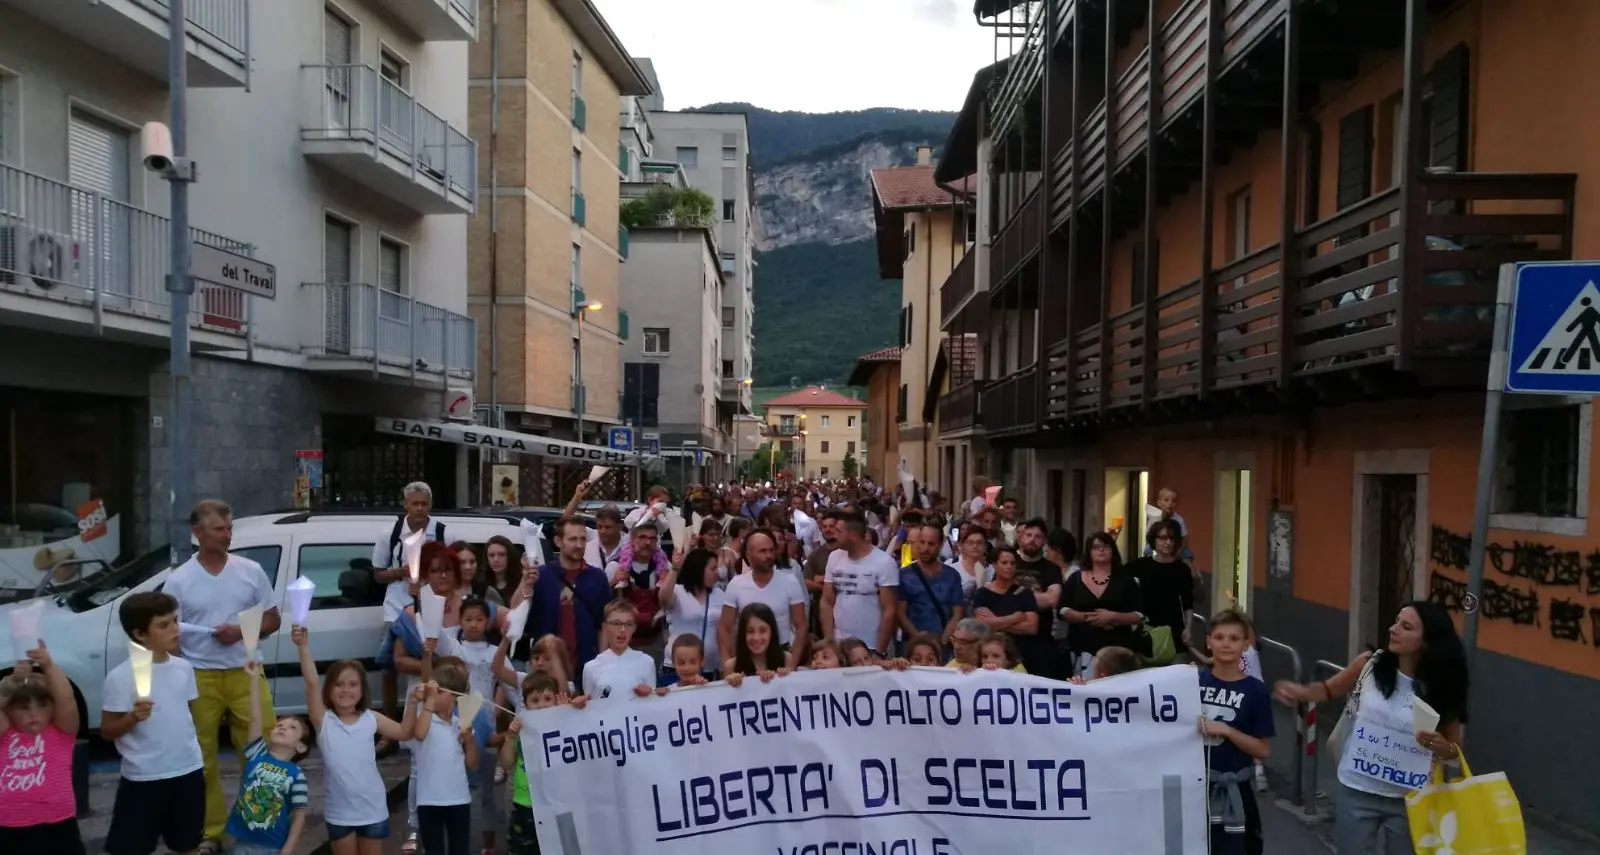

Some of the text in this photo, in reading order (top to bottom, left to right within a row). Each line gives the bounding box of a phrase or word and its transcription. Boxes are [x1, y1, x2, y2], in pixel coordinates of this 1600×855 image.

[222, 263, 239, 281] del
[243, 268, 273, 289] Travai
[392, 420, 626, 462] BAR SALA GIOCHI
[542, 684, 1178, 767] Famiglie del TRENTINO ALTO ADIGE per la
[1357, 727, 1365, 739] 1
[1383, 736, 1389, 747] 1
[1352, 757, 1427, 788] TUO FIGLIO?
[652, 757, 1088, 832] LIBERTA' DI SCELTA
